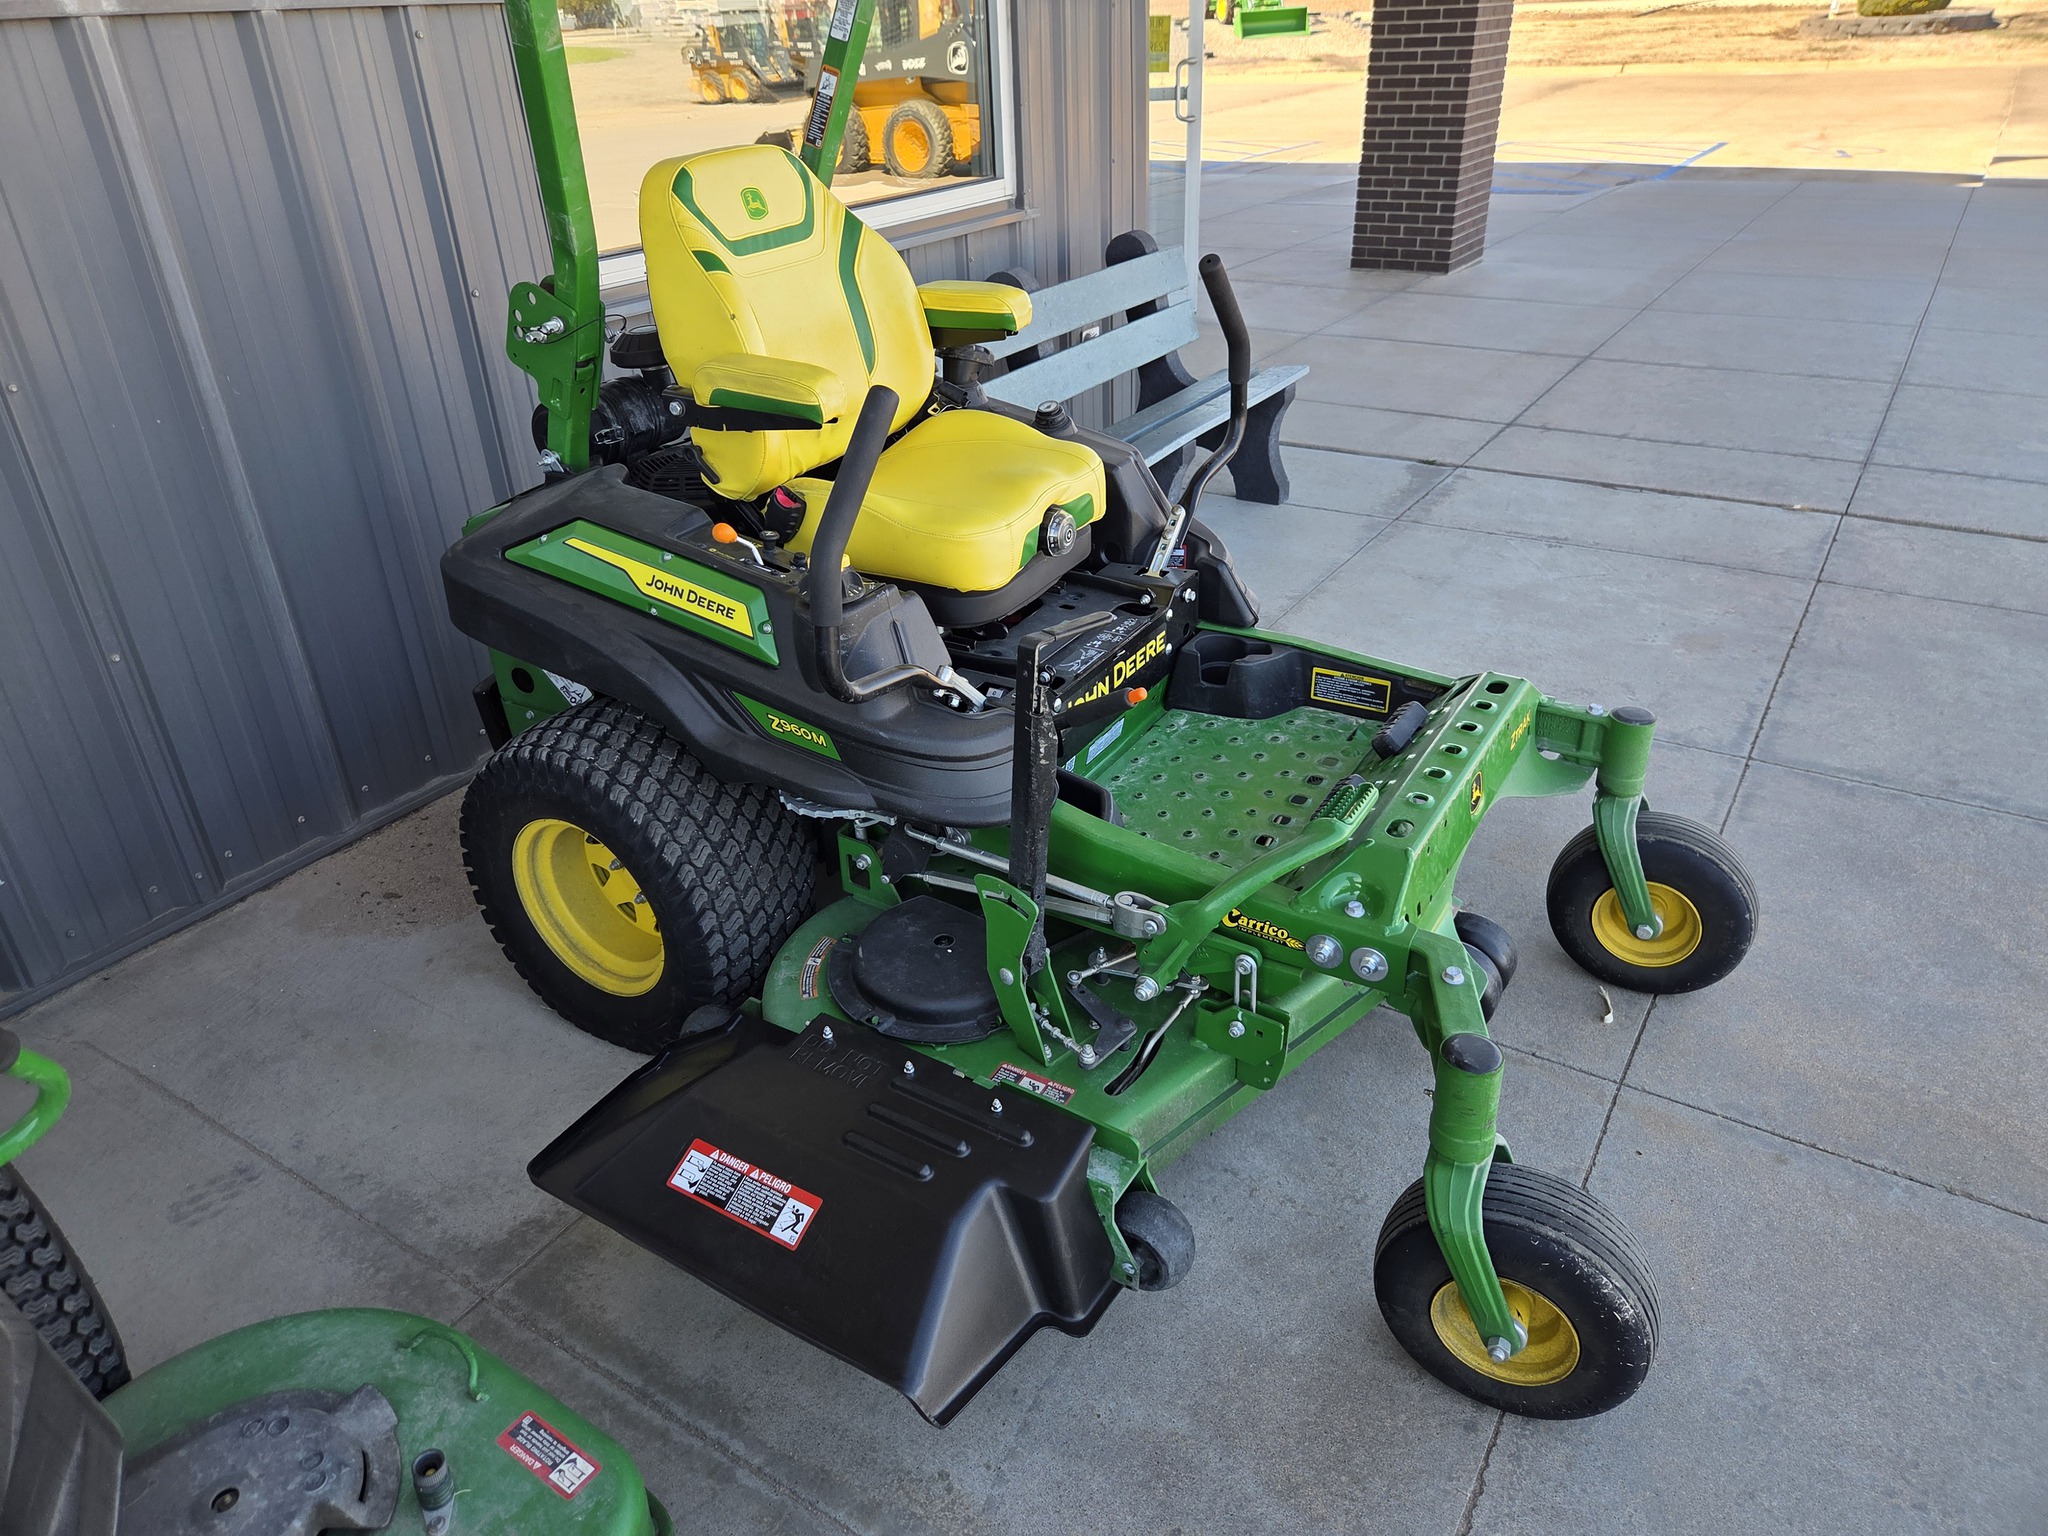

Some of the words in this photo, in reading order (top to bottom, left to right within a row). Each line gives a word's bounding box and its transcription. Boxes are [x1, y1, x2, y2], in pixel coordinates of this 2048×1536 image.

[646, 574, 684, 599] JOHN
[686, 588, 736, 620] DEERE
[1067, 675, 1110, 709] HN
[1113, 630, 1166, 689] DEERE
[766, 712, 827, 748] Z960M
[1222, 907, 1289, 940] Carrico
[1237, 926, 1285, 945] IMPLEMENT
[840, 1049, 890, 1076] NOT
[1005, 1063, 1027, 1076] DANGER
[1052, 1081, 1076, 1094] PELIGRO
[718, 1151, 750, 1174] DANGER
[758, 1172, 792, 1194] PELIGRO
[508, 1443, 535, 1465] DANGER
